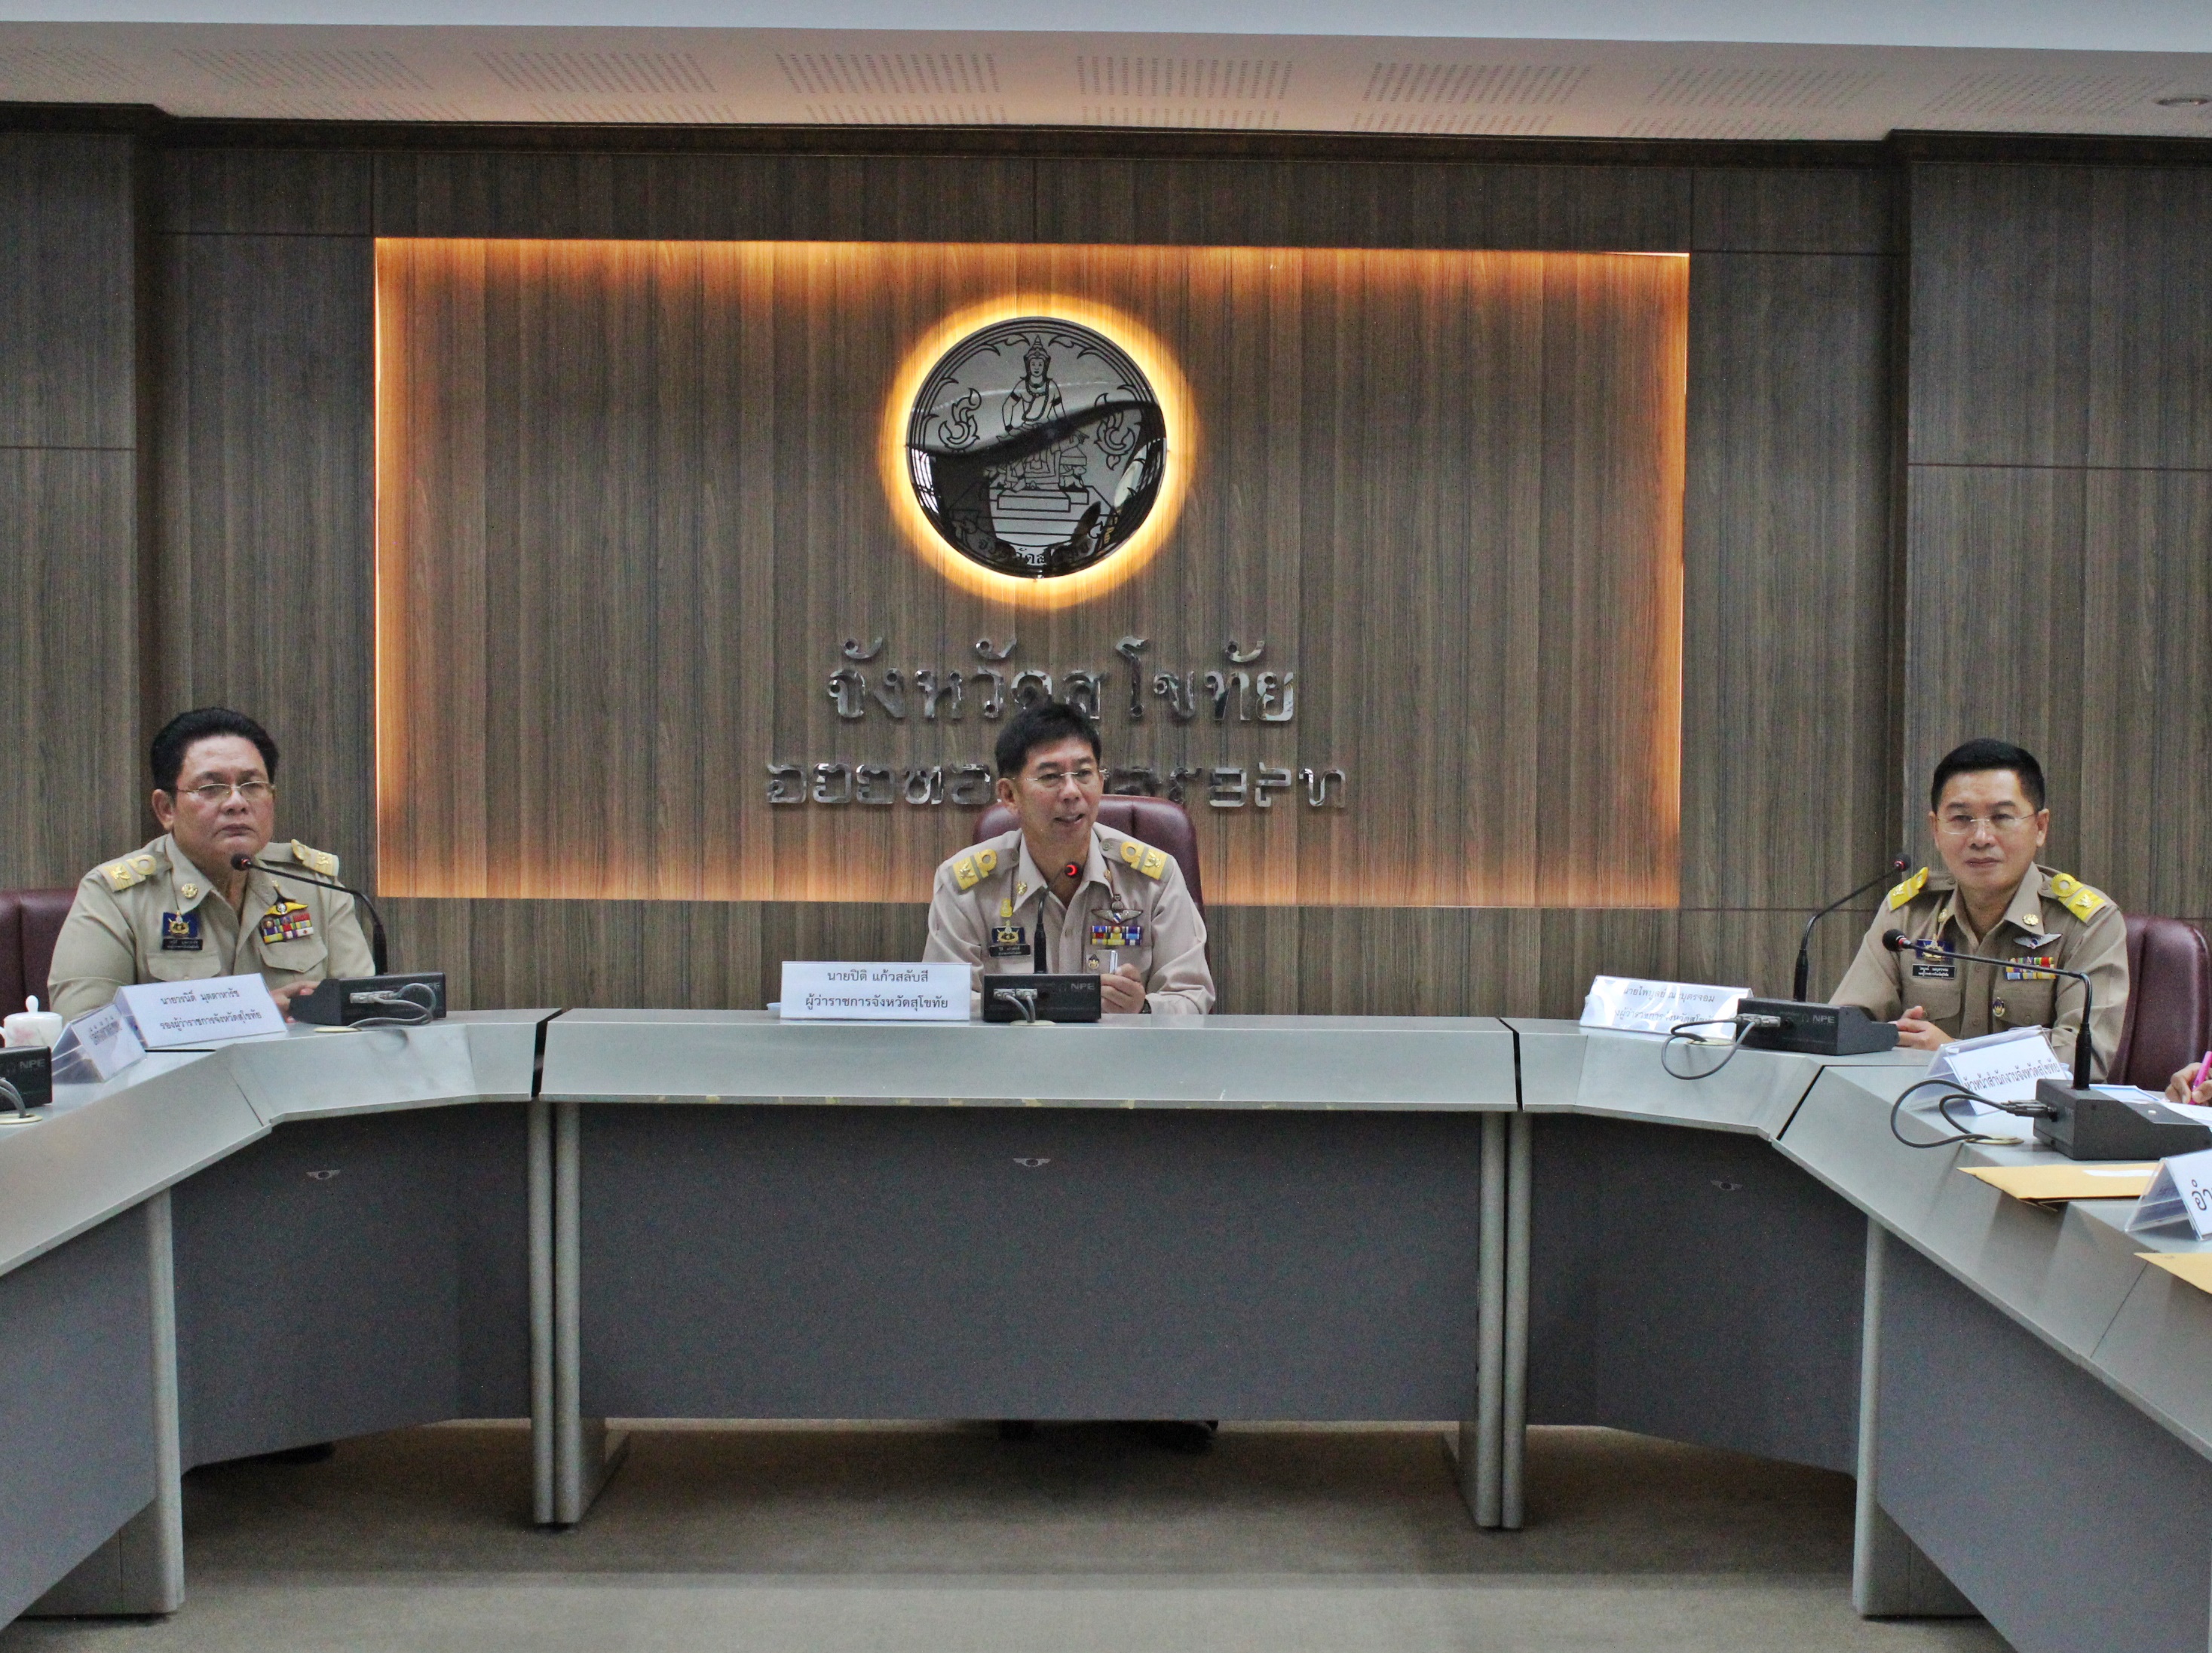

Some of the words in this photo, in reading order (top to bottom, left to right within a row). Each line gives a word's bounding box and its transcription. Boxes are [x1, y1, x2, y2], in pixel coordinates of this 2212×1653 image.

[826, 635, 1294, 721] จังหวัดสโขทัย
[827, 969, 868, 981] นายปิติ
[872, 969, 929, 982] แก้วสลับสี
[805, 993, 948, 1011] ผู้ว่าราชการจังหวัดสุโขทัย
[1812, 1015, 1836, 1024] NPE
[19, 1058, 46, 1070] NPE
